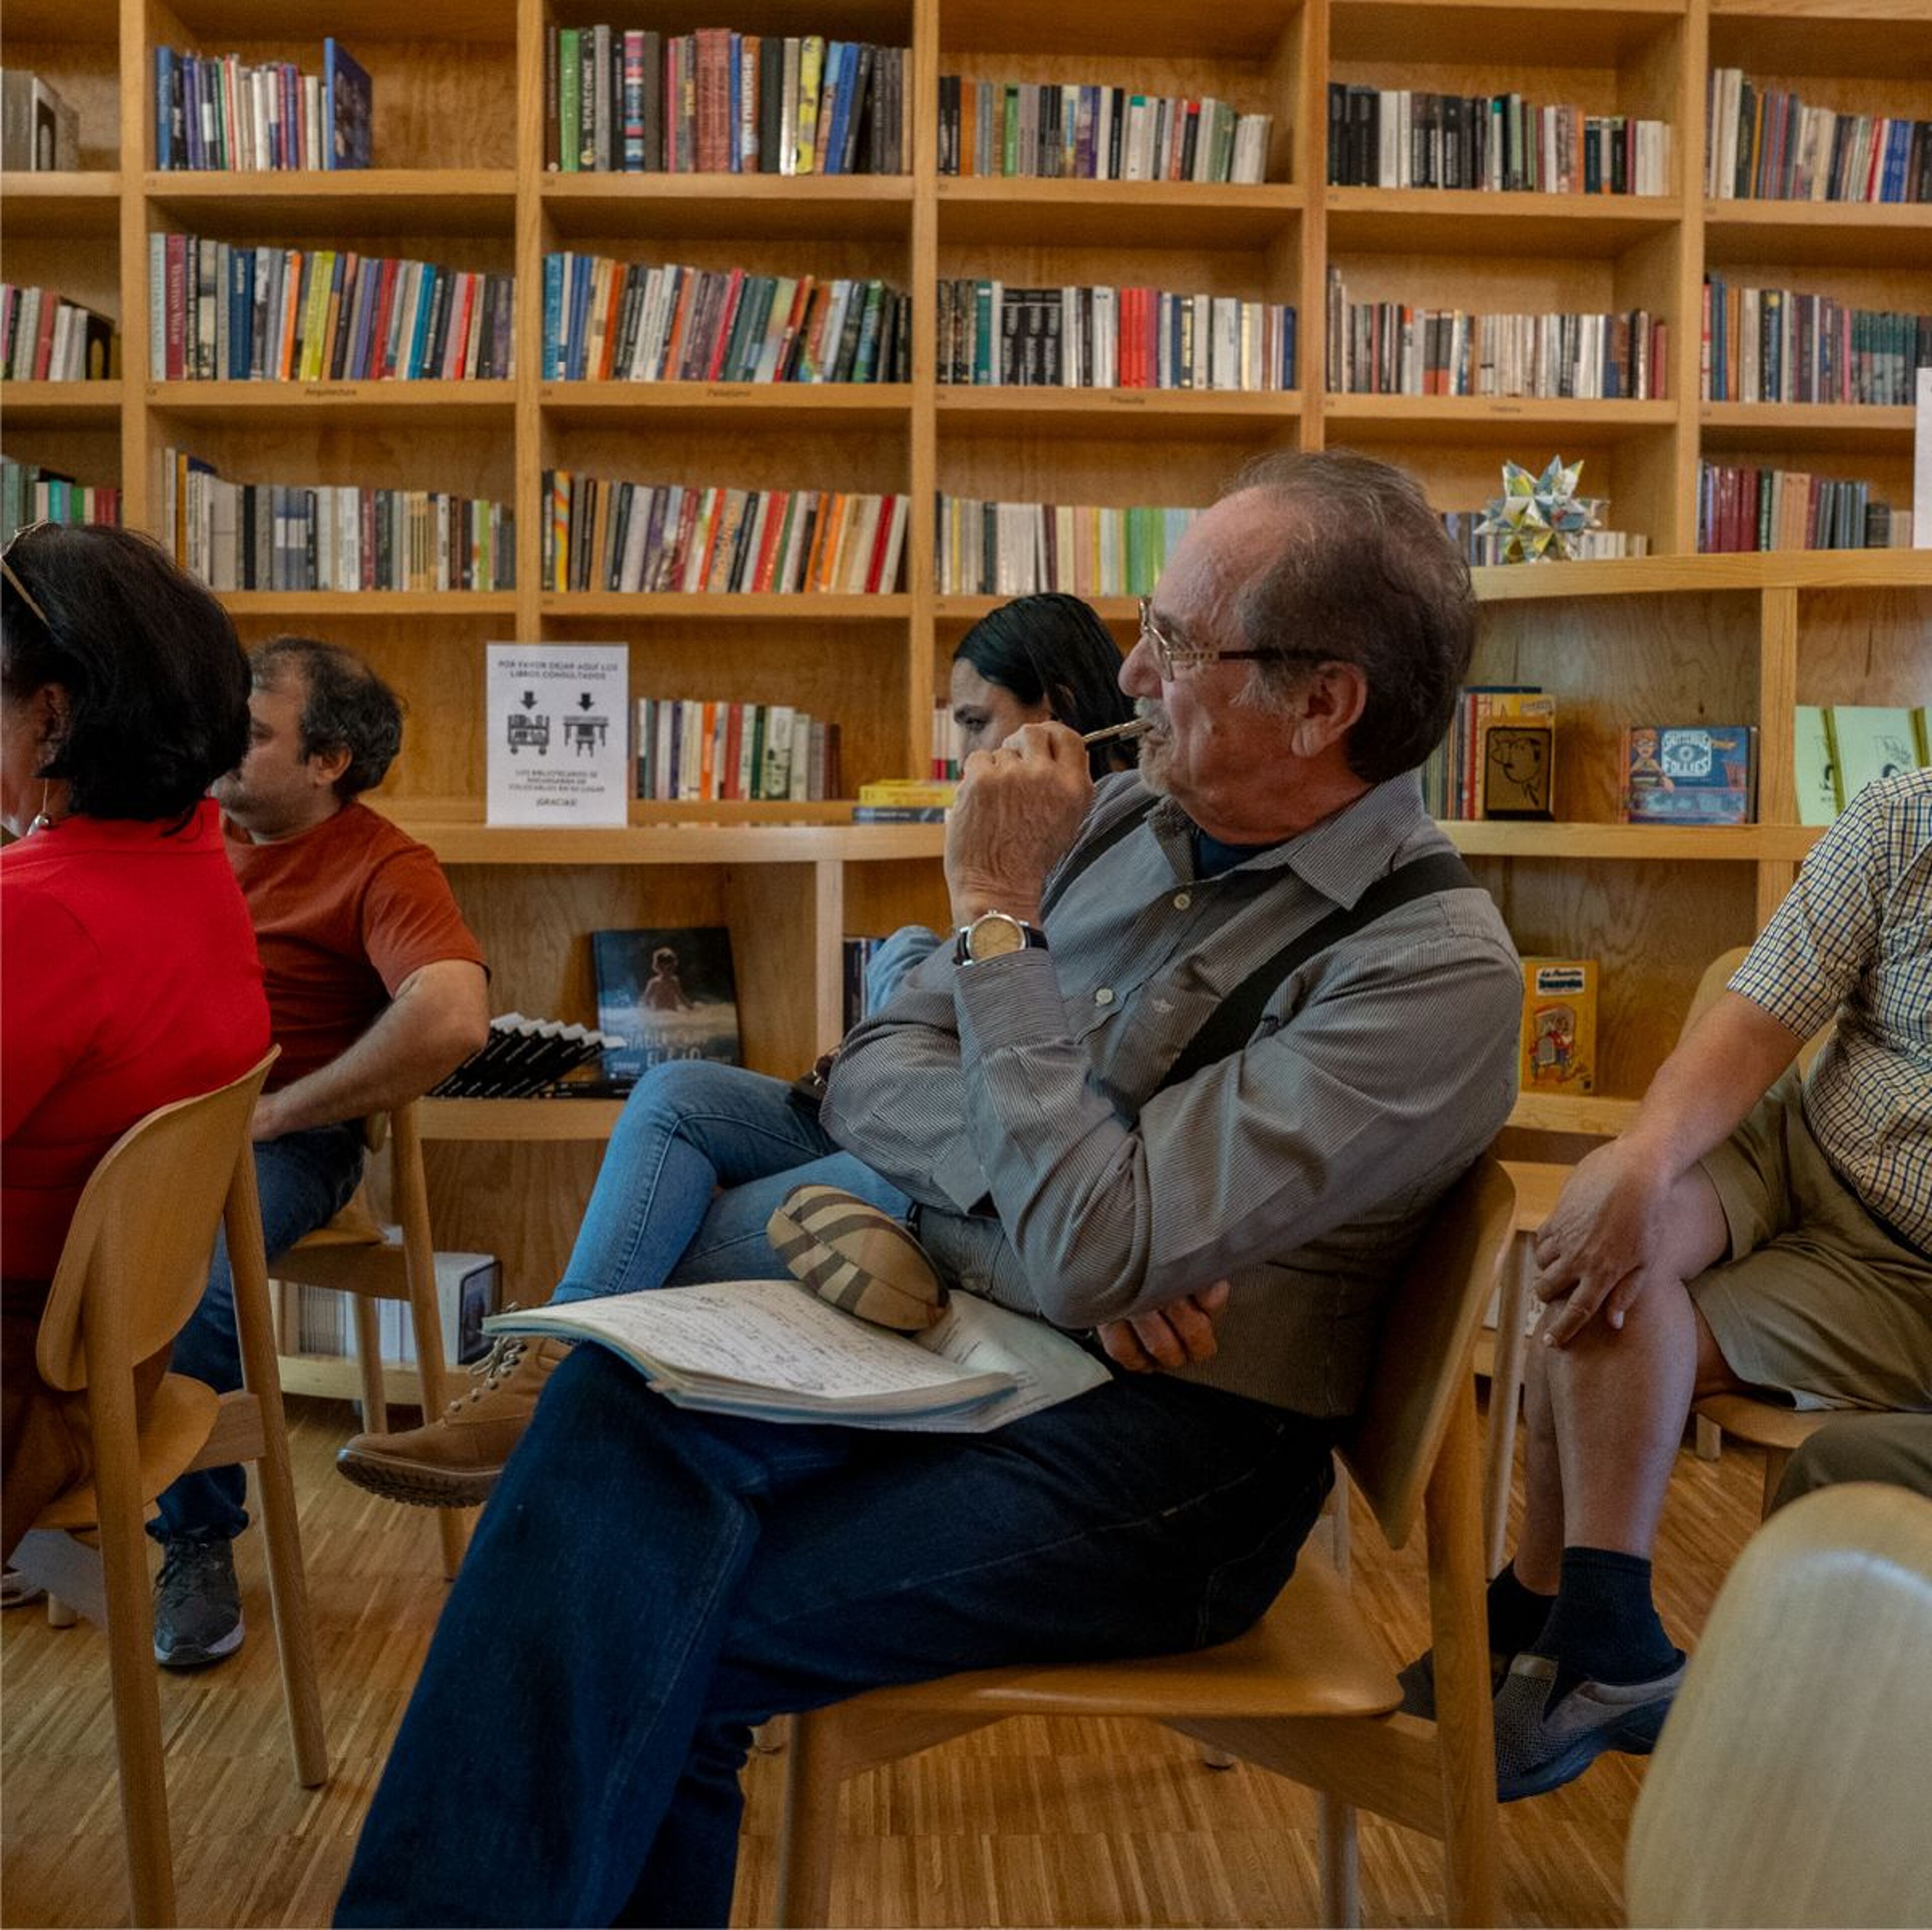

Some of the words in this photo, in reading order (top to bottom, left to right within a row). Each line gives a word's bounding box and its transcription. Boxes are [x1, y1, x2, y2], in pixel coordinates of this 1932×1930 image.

[518, 660, 546, 668] FAVOR
[601, 663, 618, 671] LOS
[542, 671, 606, 679] CONSULTADOS
[1664, 757, 1709, 774] FOLLIES
